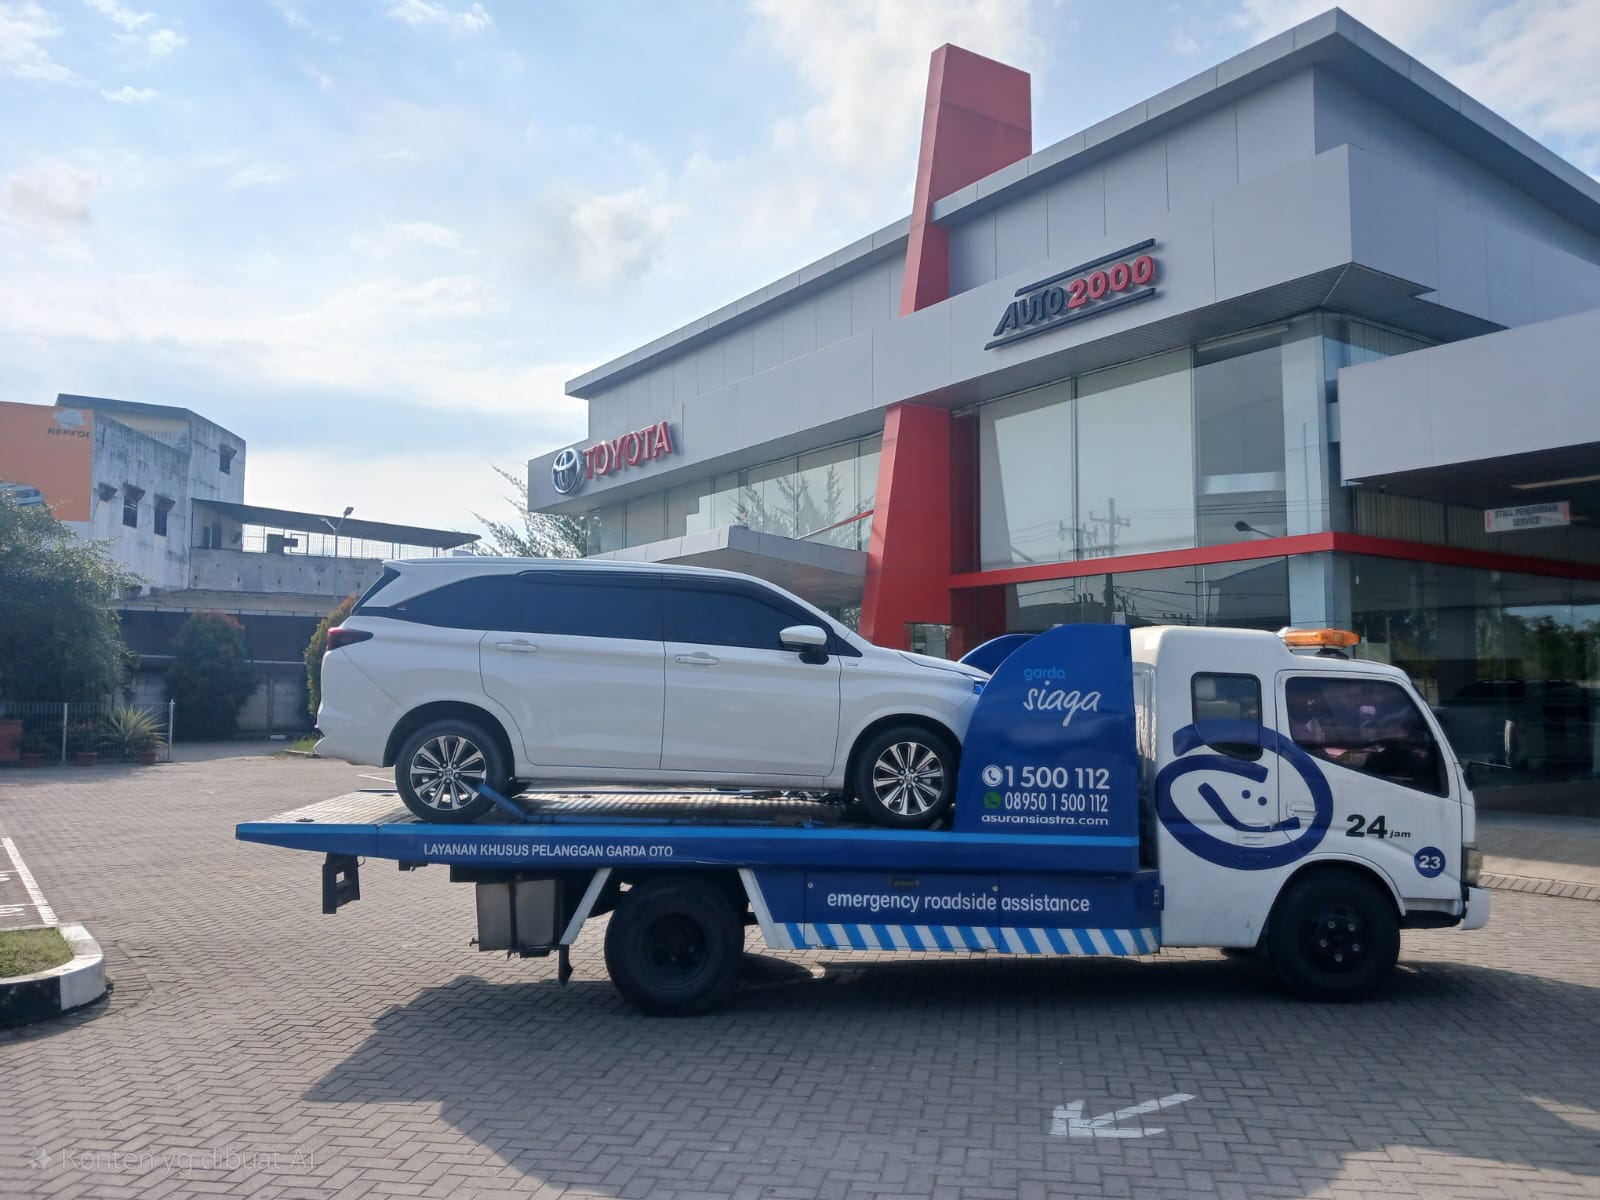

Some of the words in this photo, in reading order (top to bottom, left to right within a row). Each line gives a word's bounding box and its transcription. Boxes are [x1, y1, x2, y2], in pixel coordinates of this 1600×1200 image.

[583, 421, 672, 479] TOYOTA
[1512, 517, 1541, 527] SERVICE
[1024, 667, 1066, 680] garda
[1023, 680, 1102, 727] siaga
[1005, 766, 1014, 787] 1
[1020, 766, 1068, 789] 500
[1075, 767, 1110, 789] 112
[1005, 792, 1047, 810] 08950
[1051, 794, 1056, 811] 1
[1060, 794, 1085, 812] 500
[1089, 795, 1108, 812] 112
[981, 814, 1109, 826] asuransiastra.com
[1345, 814, 1387, 839] 24
[1389, 830, 1411, 838] jam
[423, 843, 477, 856] LAYANAN
[480, 844, 529, 856] KHUSUS
[531, 844, 603, 857] PELANGGAN
[606, 845, 646, 857] GARDA
[649, 846, 673, 857] OTO
[1419, 855, 1441, 869] 23
[827, 893, 920, 912] emergency
[924, 893, 997, 910] roadside
[1001, 894, 1090, 912] assistance
